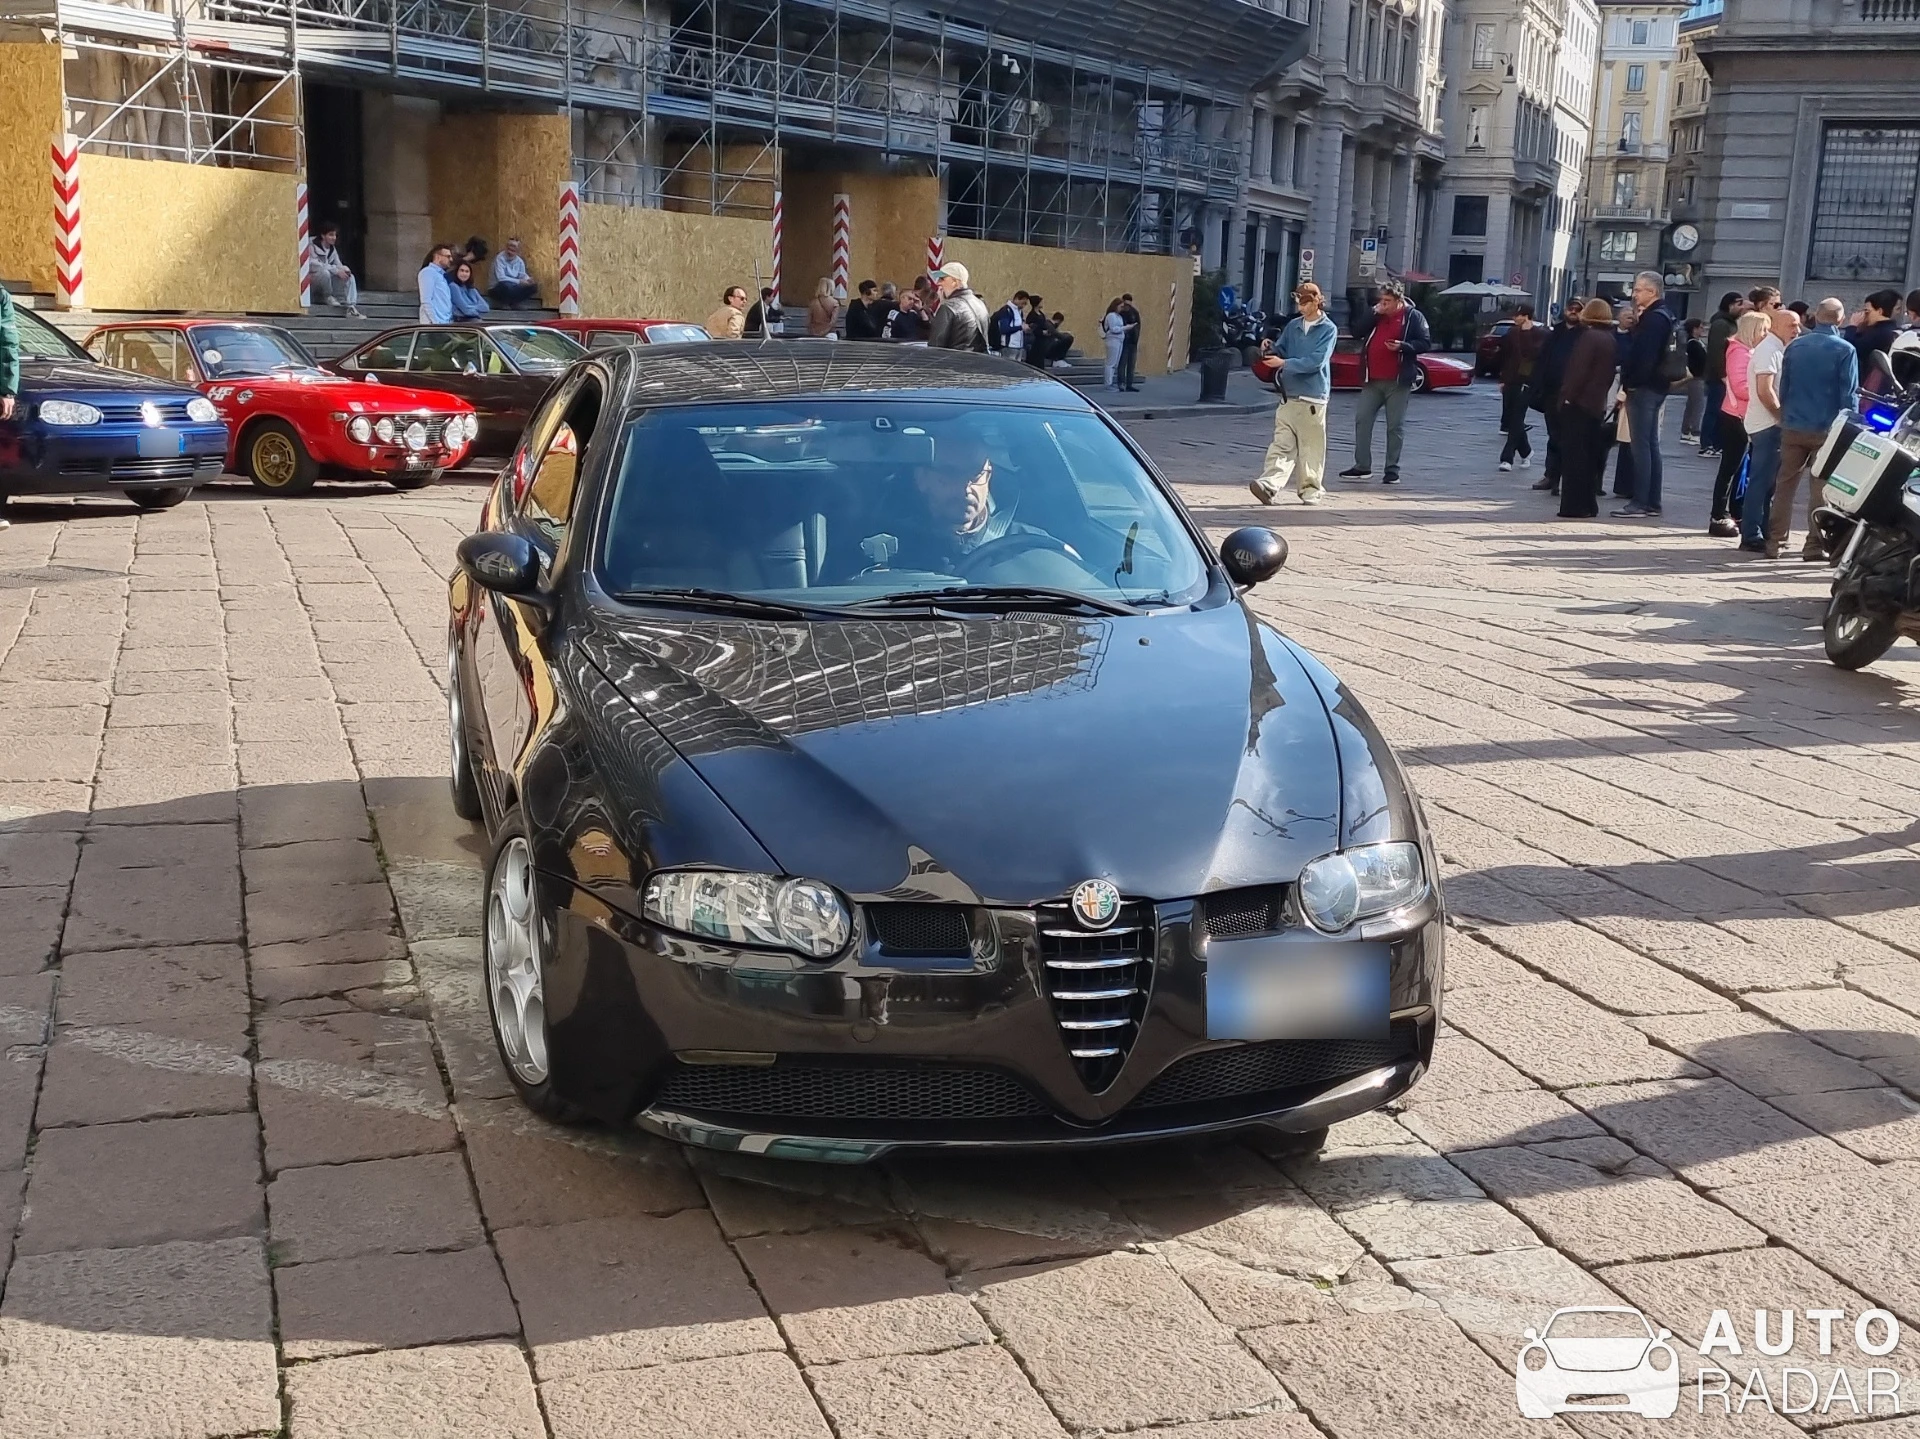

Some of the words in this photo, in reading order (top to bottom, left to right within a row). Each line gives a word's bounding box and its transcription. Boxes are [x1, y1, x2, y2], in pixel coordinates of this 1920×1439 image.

[1366, 241, 1374, 250] P
[207, 386, 236, 401] HF
[1077, 885, 1092, 906] ALFA
[1094, 882, 1118, 903] ROMEO
